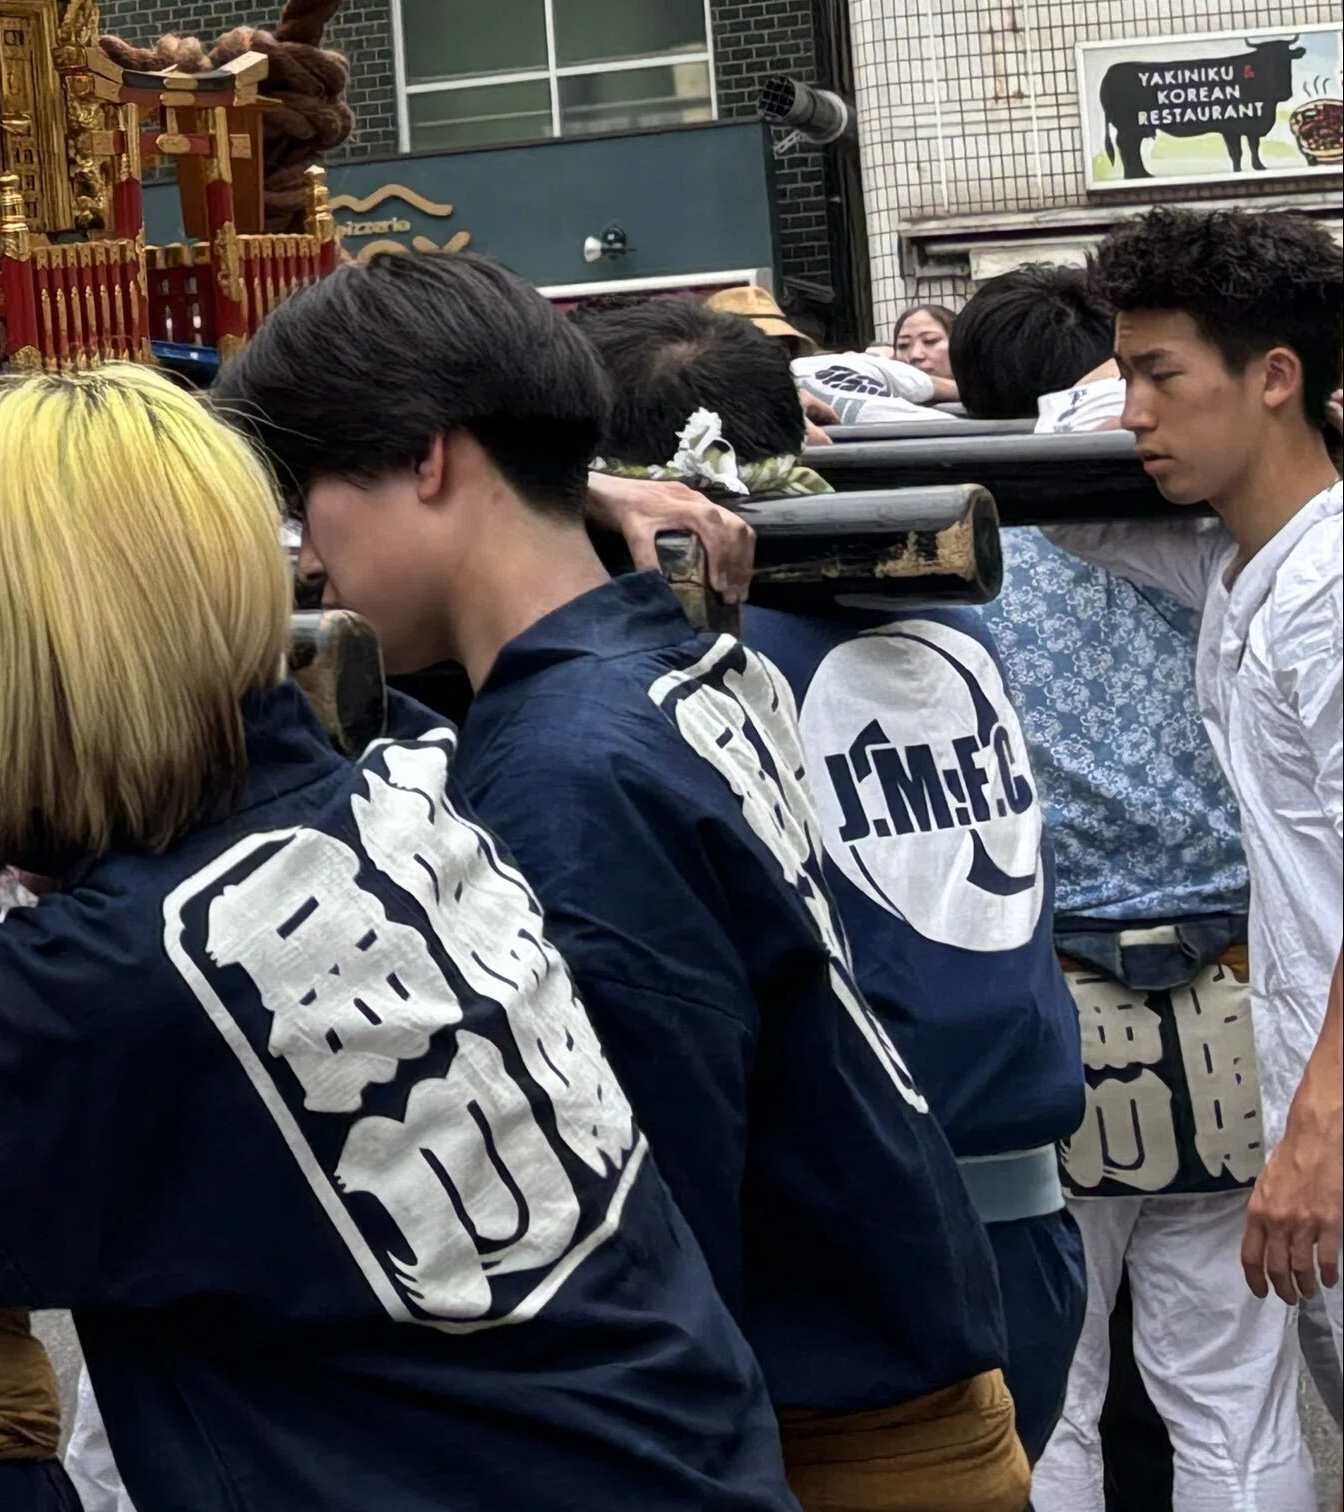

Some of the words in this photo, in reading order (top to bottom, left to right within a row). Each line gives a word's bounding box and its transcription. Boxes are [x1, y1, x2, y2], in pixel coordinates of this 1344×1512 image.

[1138, 65, 1234, 87] YAKINIKU
[1157, 84, 1241, 105] KOREAN
[1138, 101, 1264, 126] RESTAURANT
